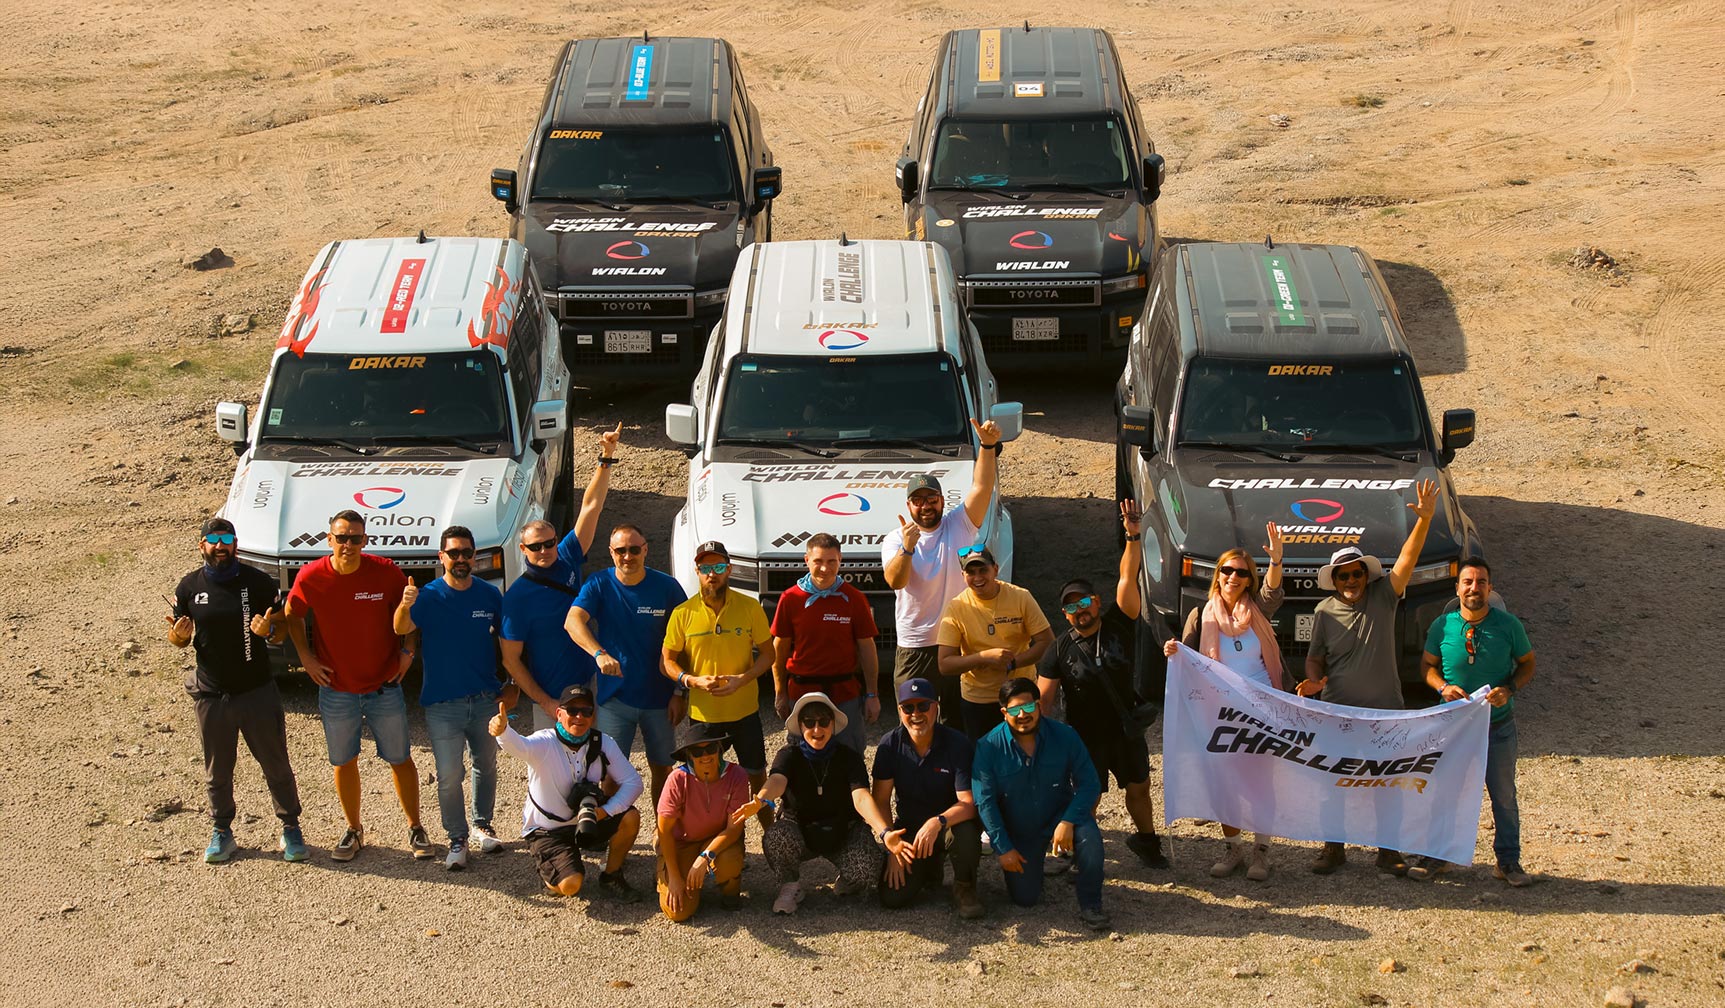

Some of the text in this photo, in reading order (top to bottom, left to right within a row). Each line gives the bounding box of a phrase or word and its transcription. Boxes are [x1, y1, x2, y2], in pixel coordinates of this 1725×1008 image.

[550, 130, 603, 140] DAKAR
[962, 208, 1104, 218] CHALLENGE
[545, 222, 718, 232] CHALLENGE
[995, 261, 1070, 270] WIALON
[591, 267, 667, 276] WIALON
[838, 252, 862, 303] CHALLENGE
[823, 278, 836, 301] WIALON
[1009, 290, 1060, 298] TOYOTA
[602, 302, 652, 311] TOYOTA
[803, 322, 879, 330] DAKAR
[349, 356, 427, 370] DAKAR
[1267, 365, 1333, 376] DAKAR
[291, 467, 463, 478] CHALLENGE
[750, 464, 837, 473] WIALON
[741, 469, 951, 483] CHALLENGE
[1208, 478, 1415, 490] CHALLENGE
[253, 480, 275, 508] wialon
[472, 476, 495, 504] wialon
[722, 493, 740, 527] wialon
[329, 513, 436, 527] ialon
[1276, 526, 1366, 535] WIALON
[366, 535, 430, 546] RTAM
[1281, 534, 1361, 544] DAKAR
[842, 573, 874, 583] OTA
[1218, 706, 1316, 747] WIALON
[1206, 726, 1444, 777] CHALLENGE
[1334, 777, 1429, 795] DAKAR
